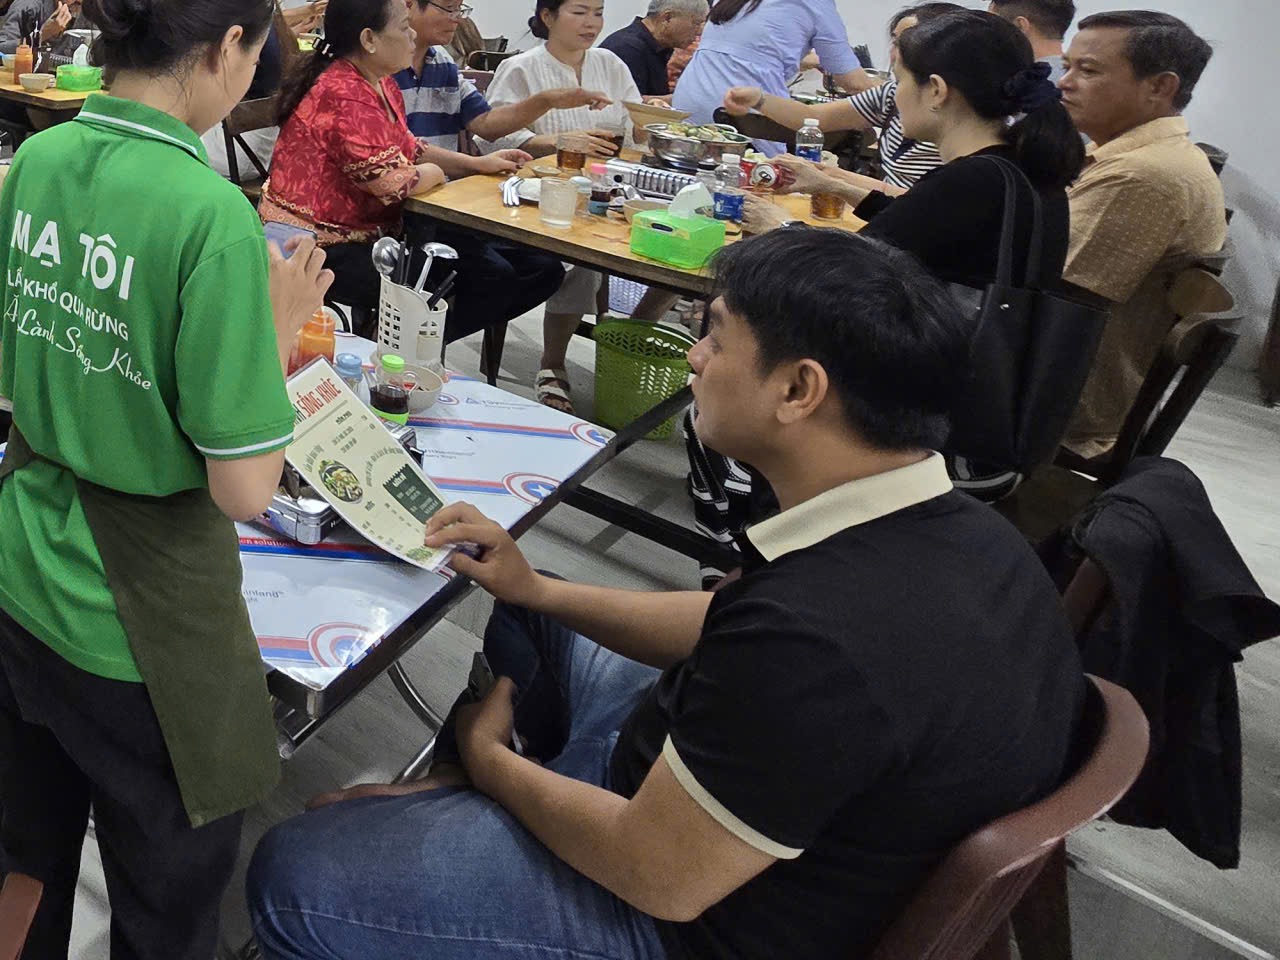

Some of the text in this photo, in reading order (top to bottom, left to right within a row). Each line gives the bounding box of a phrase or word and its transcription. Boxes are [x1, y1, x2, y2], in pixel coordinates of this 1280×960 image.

[79, 233, 134, 300] TÔI
[17, 308, 56, 344] Lành
[85, 307, 129, 341] RỪNG
[295, 392, 324, 417] SỐNG
